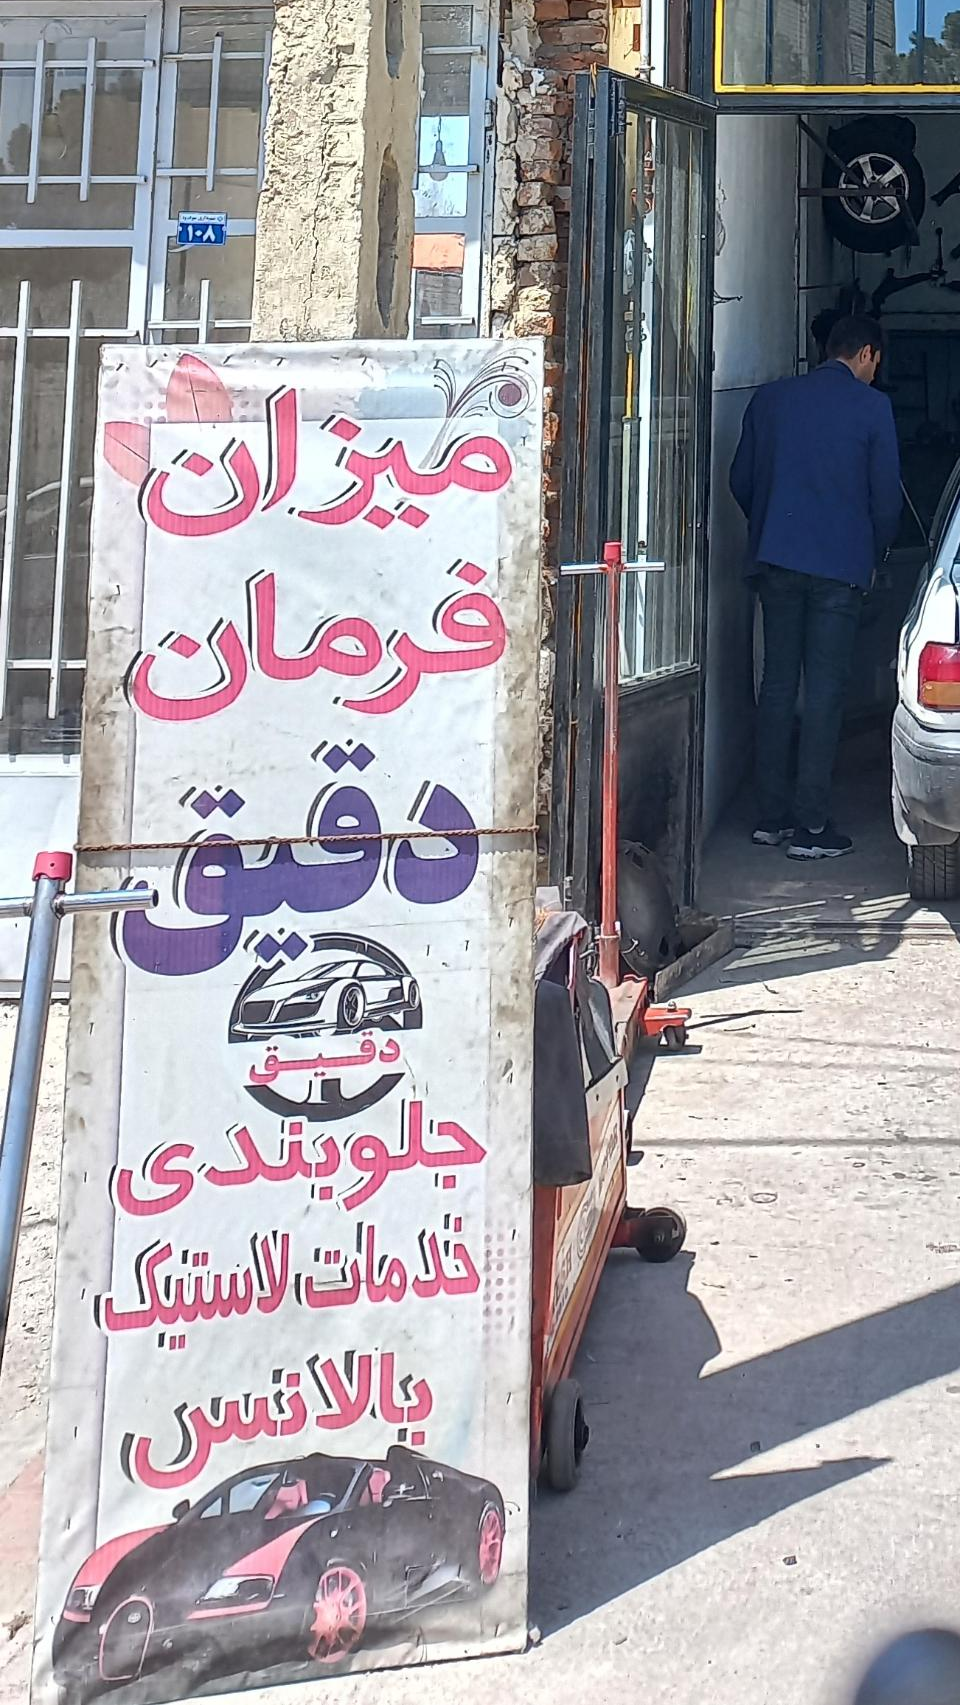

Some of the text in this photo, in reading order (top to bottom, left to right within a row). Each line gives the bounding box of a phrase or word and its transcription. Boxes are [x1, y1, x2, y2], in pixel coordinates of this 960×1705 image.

[187, 225, 216, 242] ۱۰۸
[139, 385, 513, 537] میزان
[126, 560, 505, 722] فرمان
[110, 739, 480, 976] دقیق
[249, 1030, 400, 1084] دقیق
[110, 1099, 488, 1218] جلوبندی
[94, 1212, 482, 1351] خدمات لاستیک
[120, 1348, 434, 1490] بالانس
